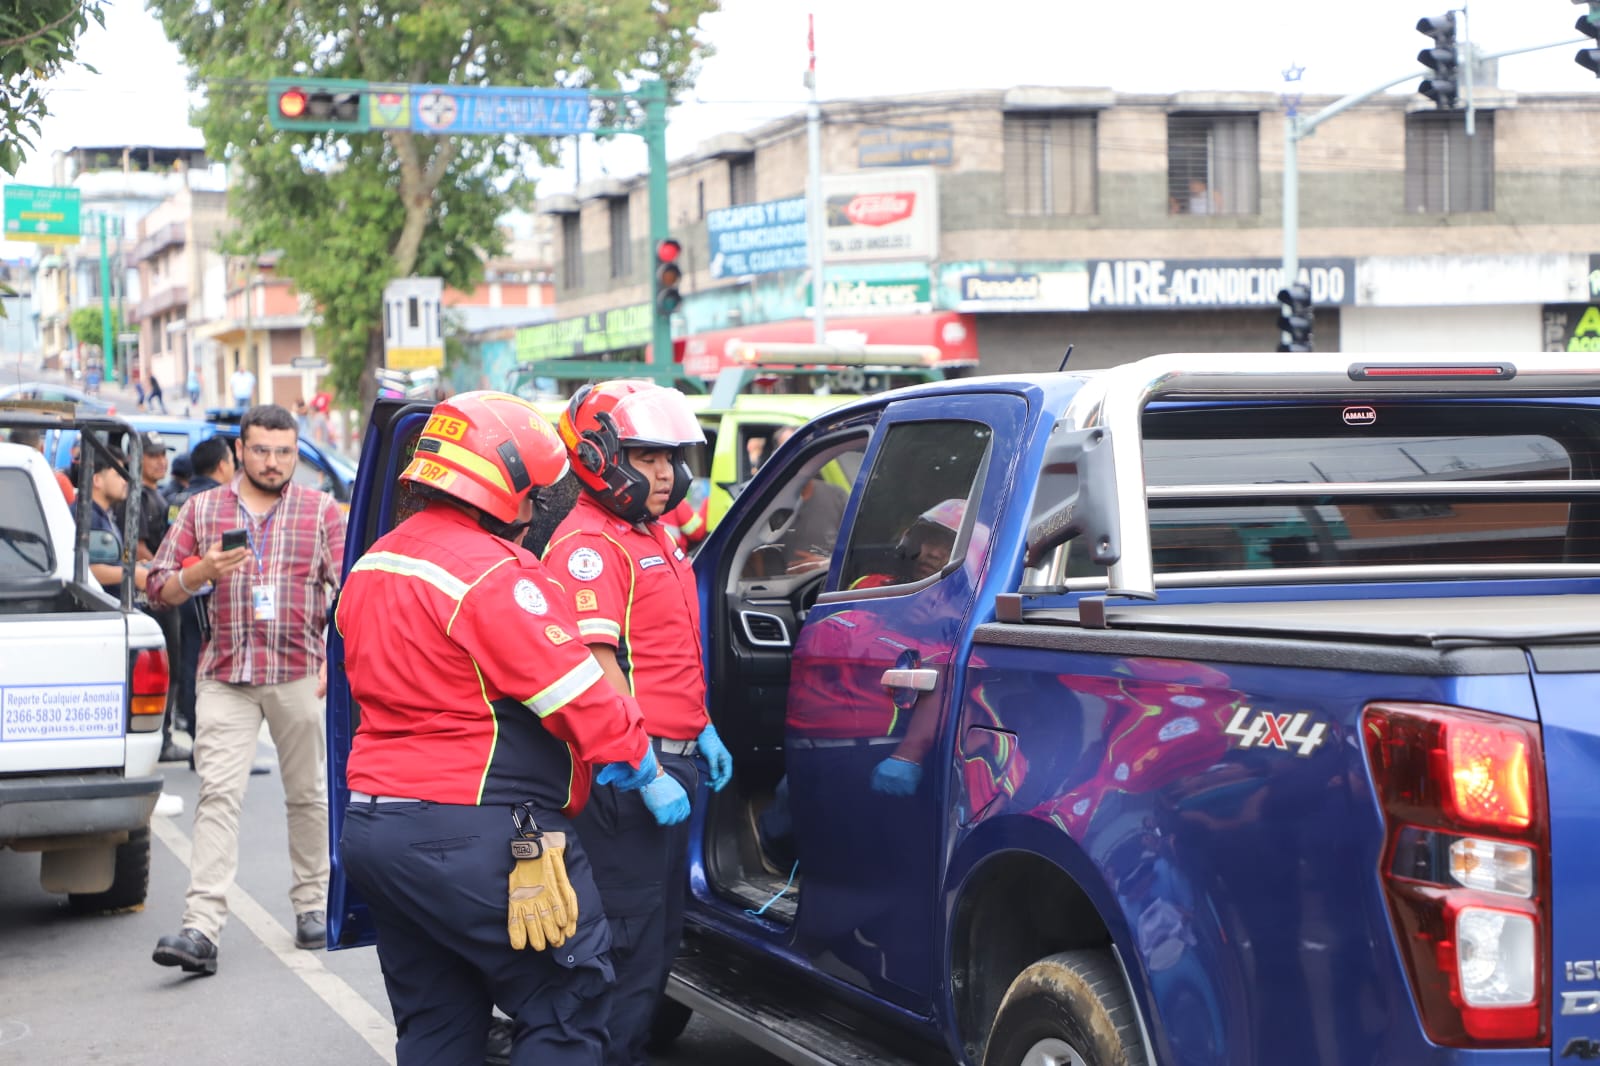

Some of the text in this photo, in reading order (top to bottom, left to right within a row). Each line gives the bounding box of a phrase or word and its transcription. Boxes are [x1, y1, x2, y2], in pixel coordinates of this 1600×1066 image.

[1090, 260, 1345, 304] AIRE ACONDICIOADO
[1345, 411, 1375, 420] AMALIE
[7, 693, 40, 707] Reporte
[42, 691, 81, 707] Cualquier
[6, 706, 119, 724] 2366-5830 2366-5961
